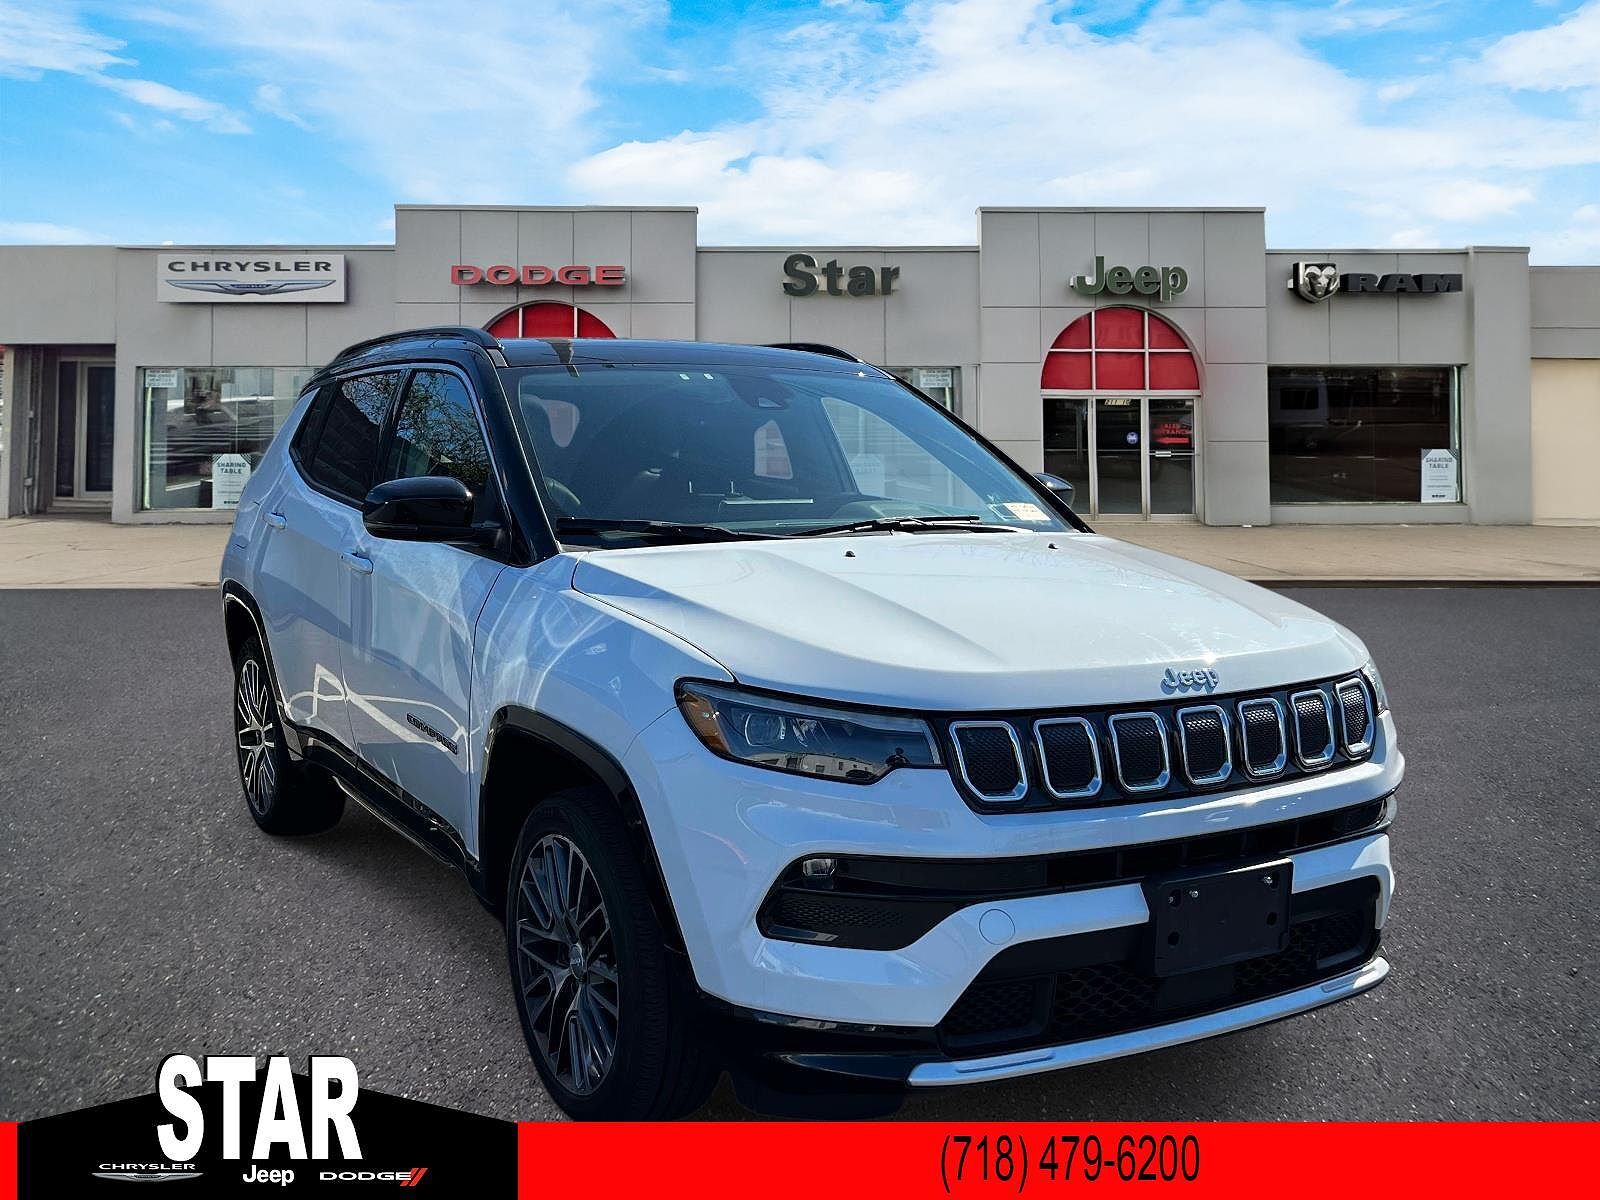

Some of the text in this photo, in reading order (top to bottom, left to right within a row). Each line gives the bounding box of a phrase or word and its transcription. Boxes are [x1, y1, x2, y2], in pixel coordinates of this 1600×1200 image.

[167, 261, 332, 272] CHRYSLER
[451, 265, 626, 286] DODGE
[783, 253, 900, 297] Star
[1071, 256, 1189, 302] Jeep
[1342, 273, 1464, 293] RAM
[1160, 667, 1219, 695] Jeep
